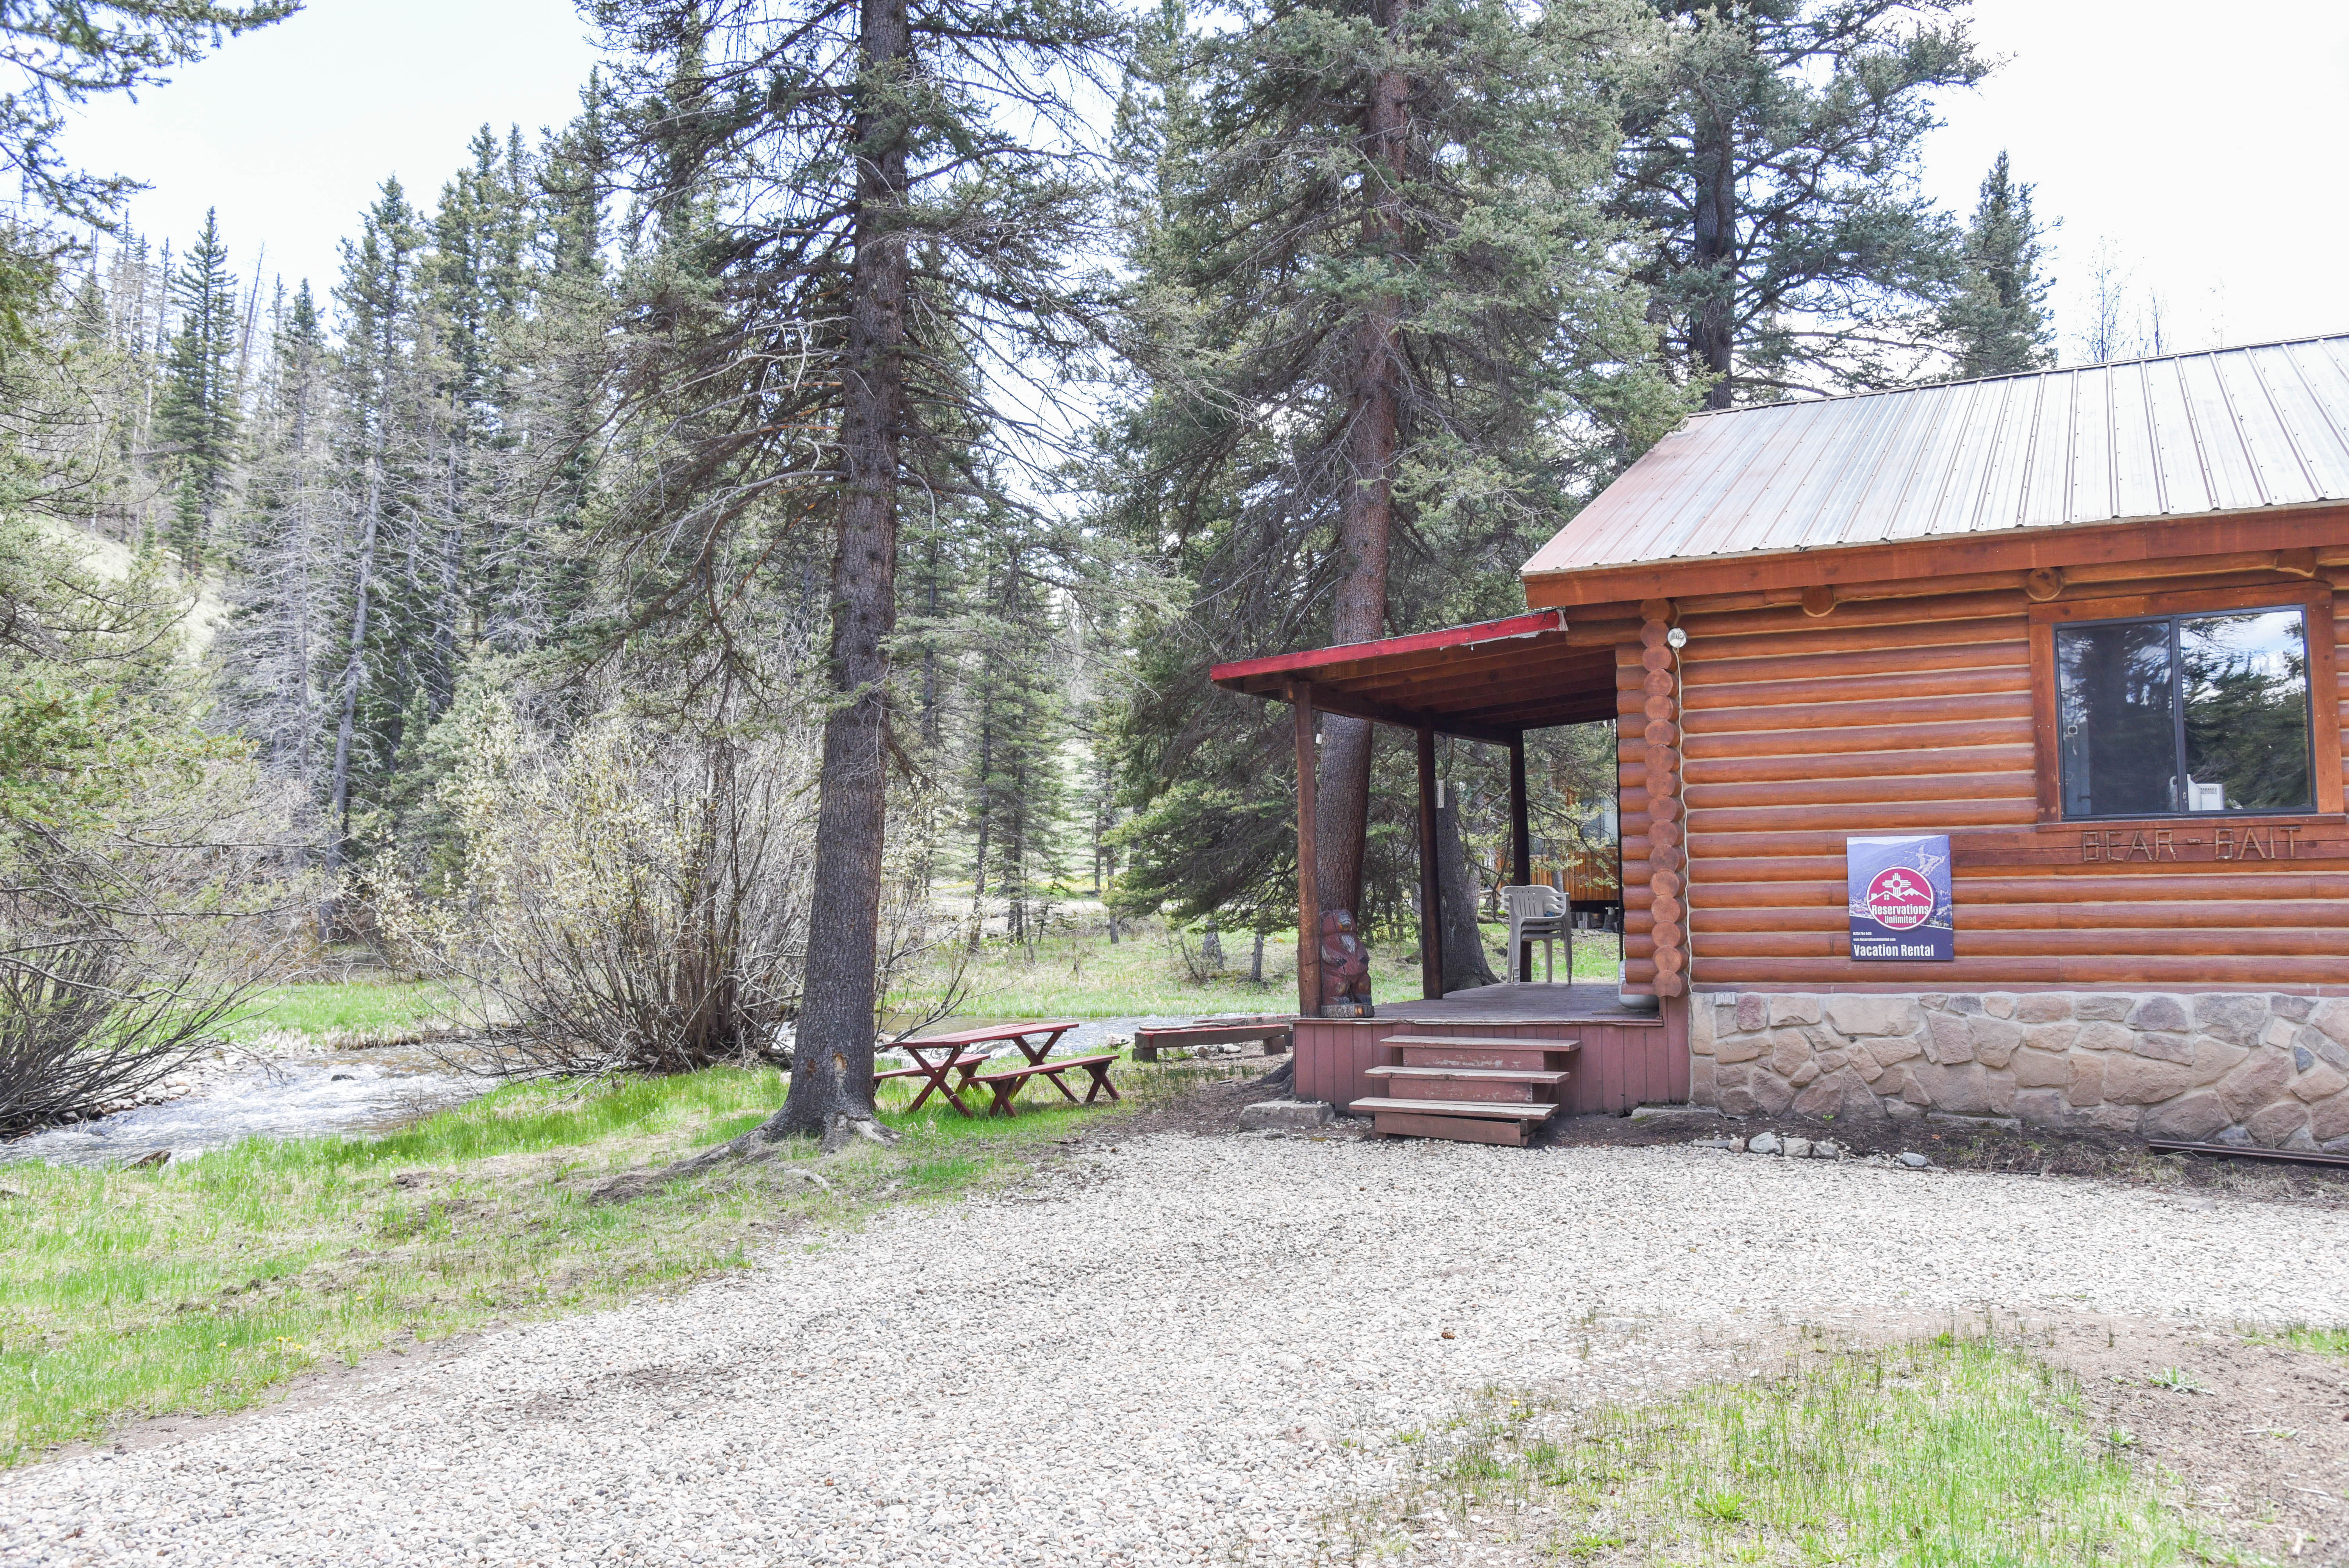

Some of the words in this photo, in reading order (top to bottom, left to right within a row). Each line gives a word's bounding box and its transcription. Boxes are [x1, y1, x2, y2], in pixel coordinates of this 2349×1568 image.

[2082, 829, 2176, 861] BEAR
[2215, 825, 2302, 860] BAIT
[1872, 904, 1929, 915] Reservations
[1885, 915, 1916, 924] Unlimited
[1854, 944, 1898, 956] Vacation
[1901, 944, 1934, 956] Rental
